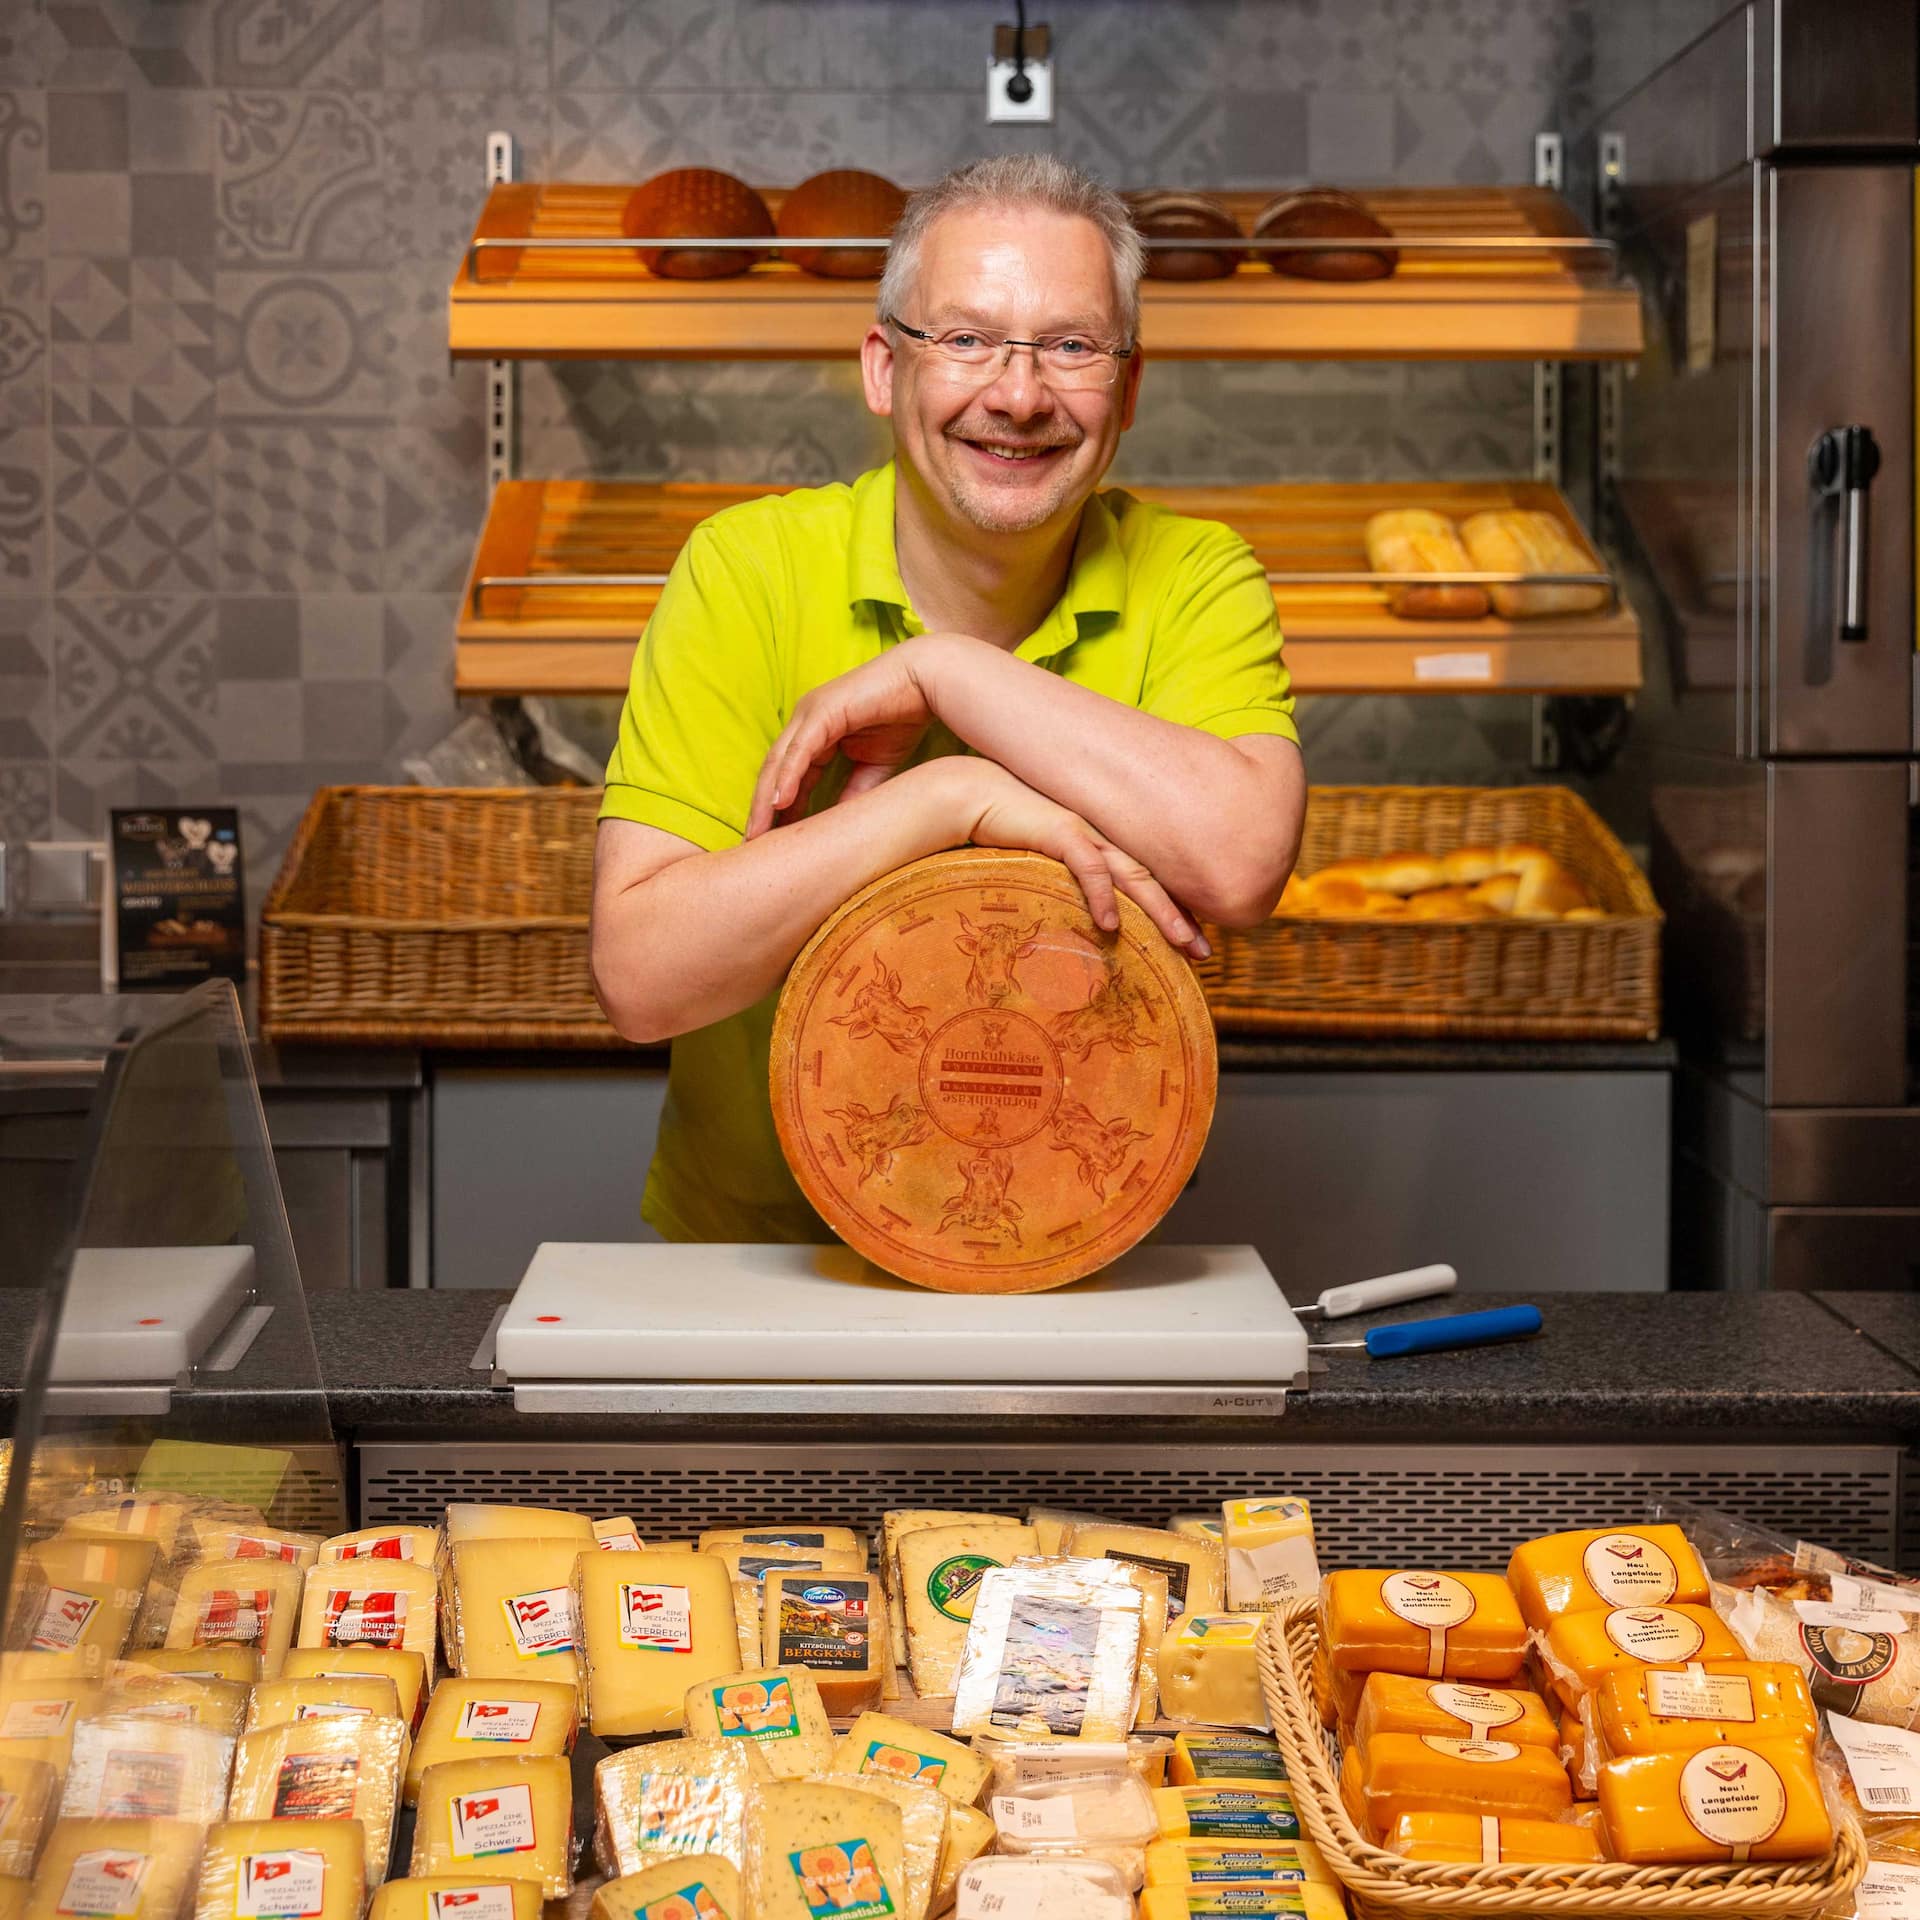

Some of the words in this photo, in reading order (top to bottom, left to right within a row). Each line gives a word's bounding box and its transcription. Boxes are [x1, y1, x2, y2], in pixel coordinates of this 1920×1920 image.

[945, 1048, 1040, 1064] Hornkuhkäse
[850, 1601, 859, 1609] 4
[517, 1629, 570, 1645] ÖSTERREI
[622, 1625, 687, 1638] ÖSTERREICH
[784, 1648, 861, 1658] BERGKÄSE
[752, 1728, 793, 1740] matisch
[1703, 1805, 1758, 1815] Goldbarren
[474, 1836, 523, 1850] Schweiz
